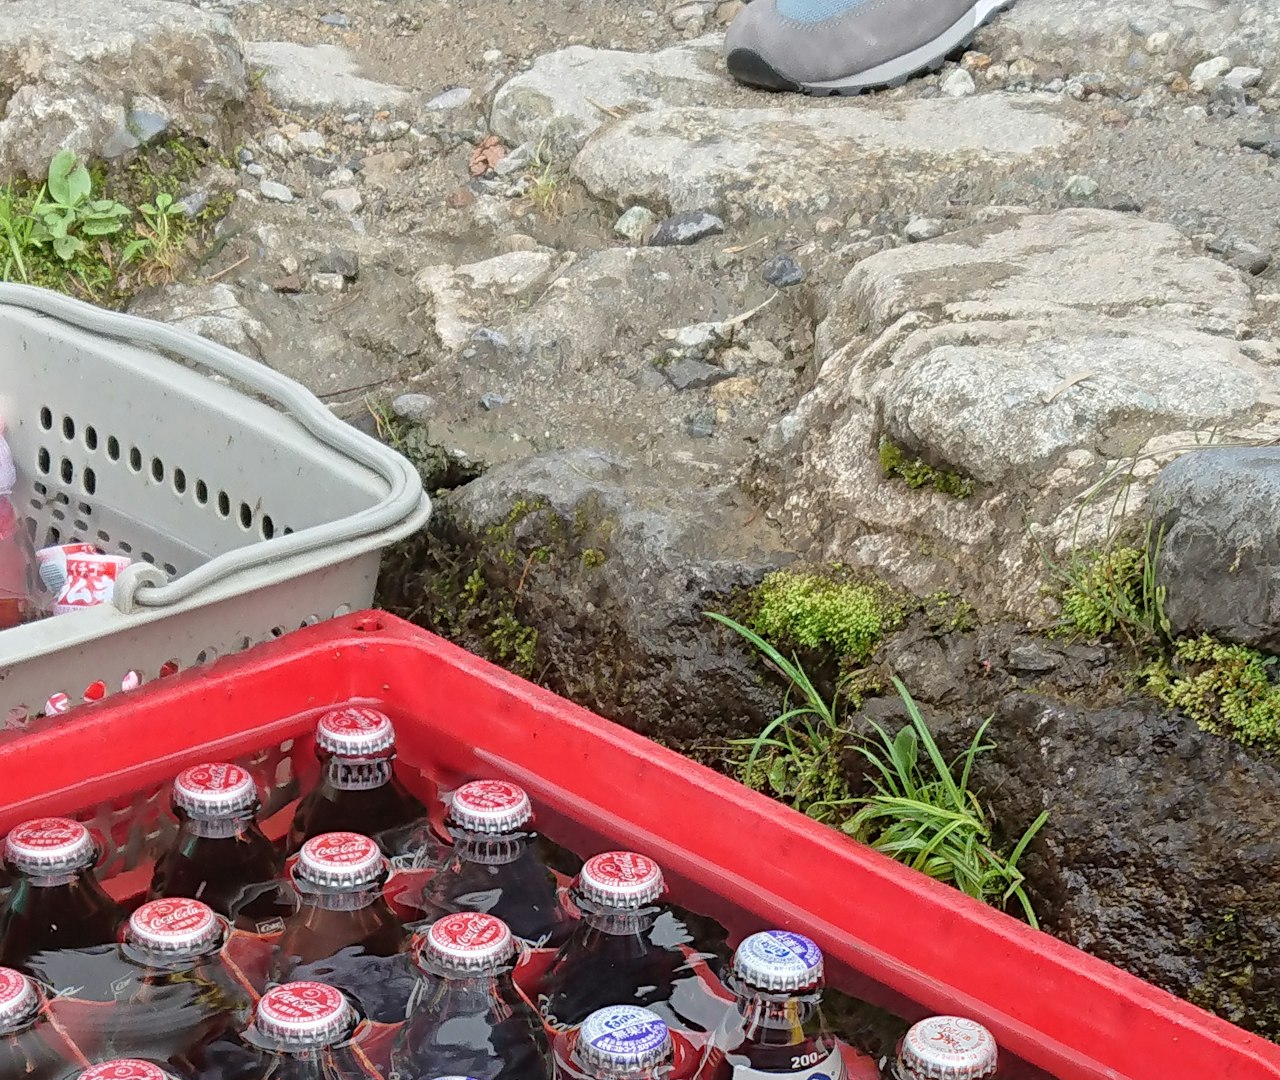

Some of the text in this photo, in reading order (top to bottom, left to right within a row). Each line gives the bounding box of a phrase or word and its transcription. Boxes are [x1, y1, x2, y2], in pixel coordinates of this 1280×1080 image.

[18, 828, 74, 839] Coca-Cola
[316, 842, 370, 858] Coca-Cola
[150, 904, 204, 929] Coca-Cola
[456, 915, 493, 946] Coca-Cola
[270, 991, 327, 1014] Coca-Cola
[604, 1013, 637, 1030] Fanta
